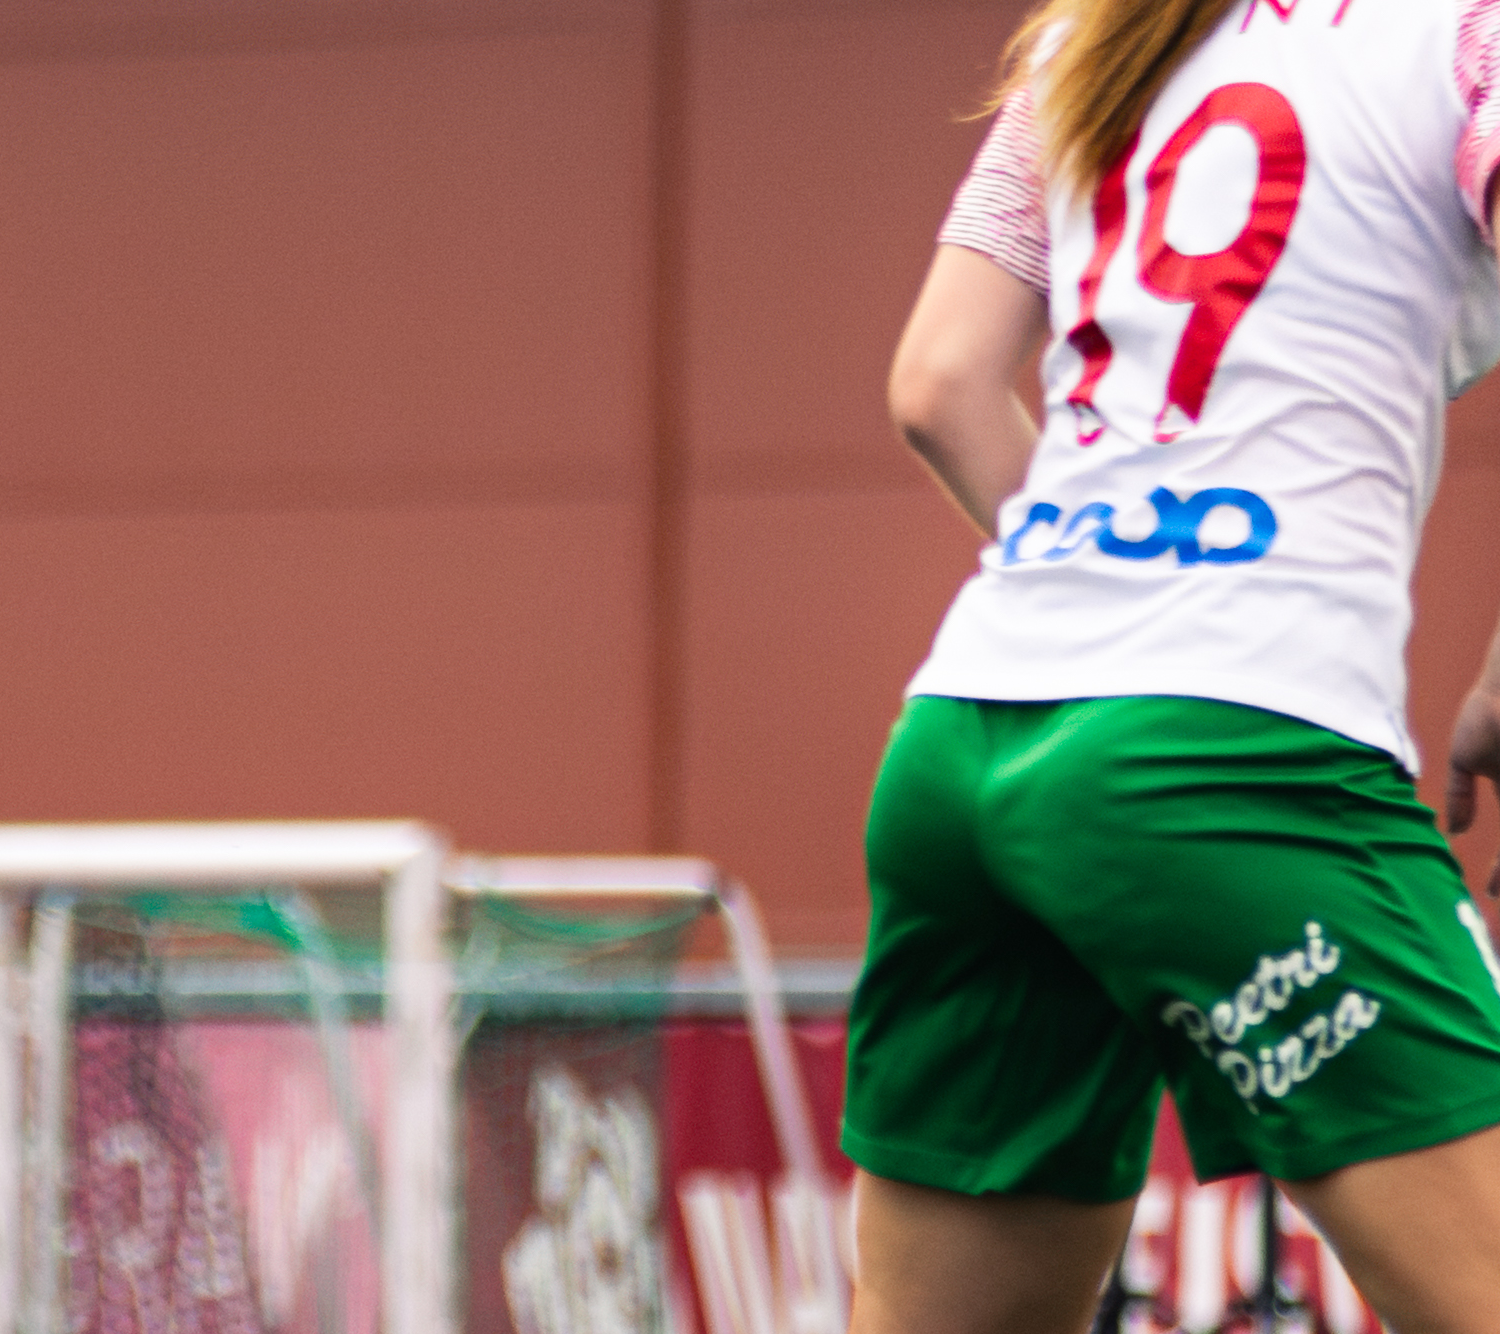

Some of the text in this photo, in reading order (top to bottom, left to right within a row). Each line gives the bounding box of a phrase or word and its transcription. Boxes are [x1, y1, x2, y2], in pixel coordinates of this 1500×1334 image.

[1067, 80, 1309, 447] 19
[1162, 920, 1341, 1060] Peetri
[1216, 991, 1382, 1116] Pizza
